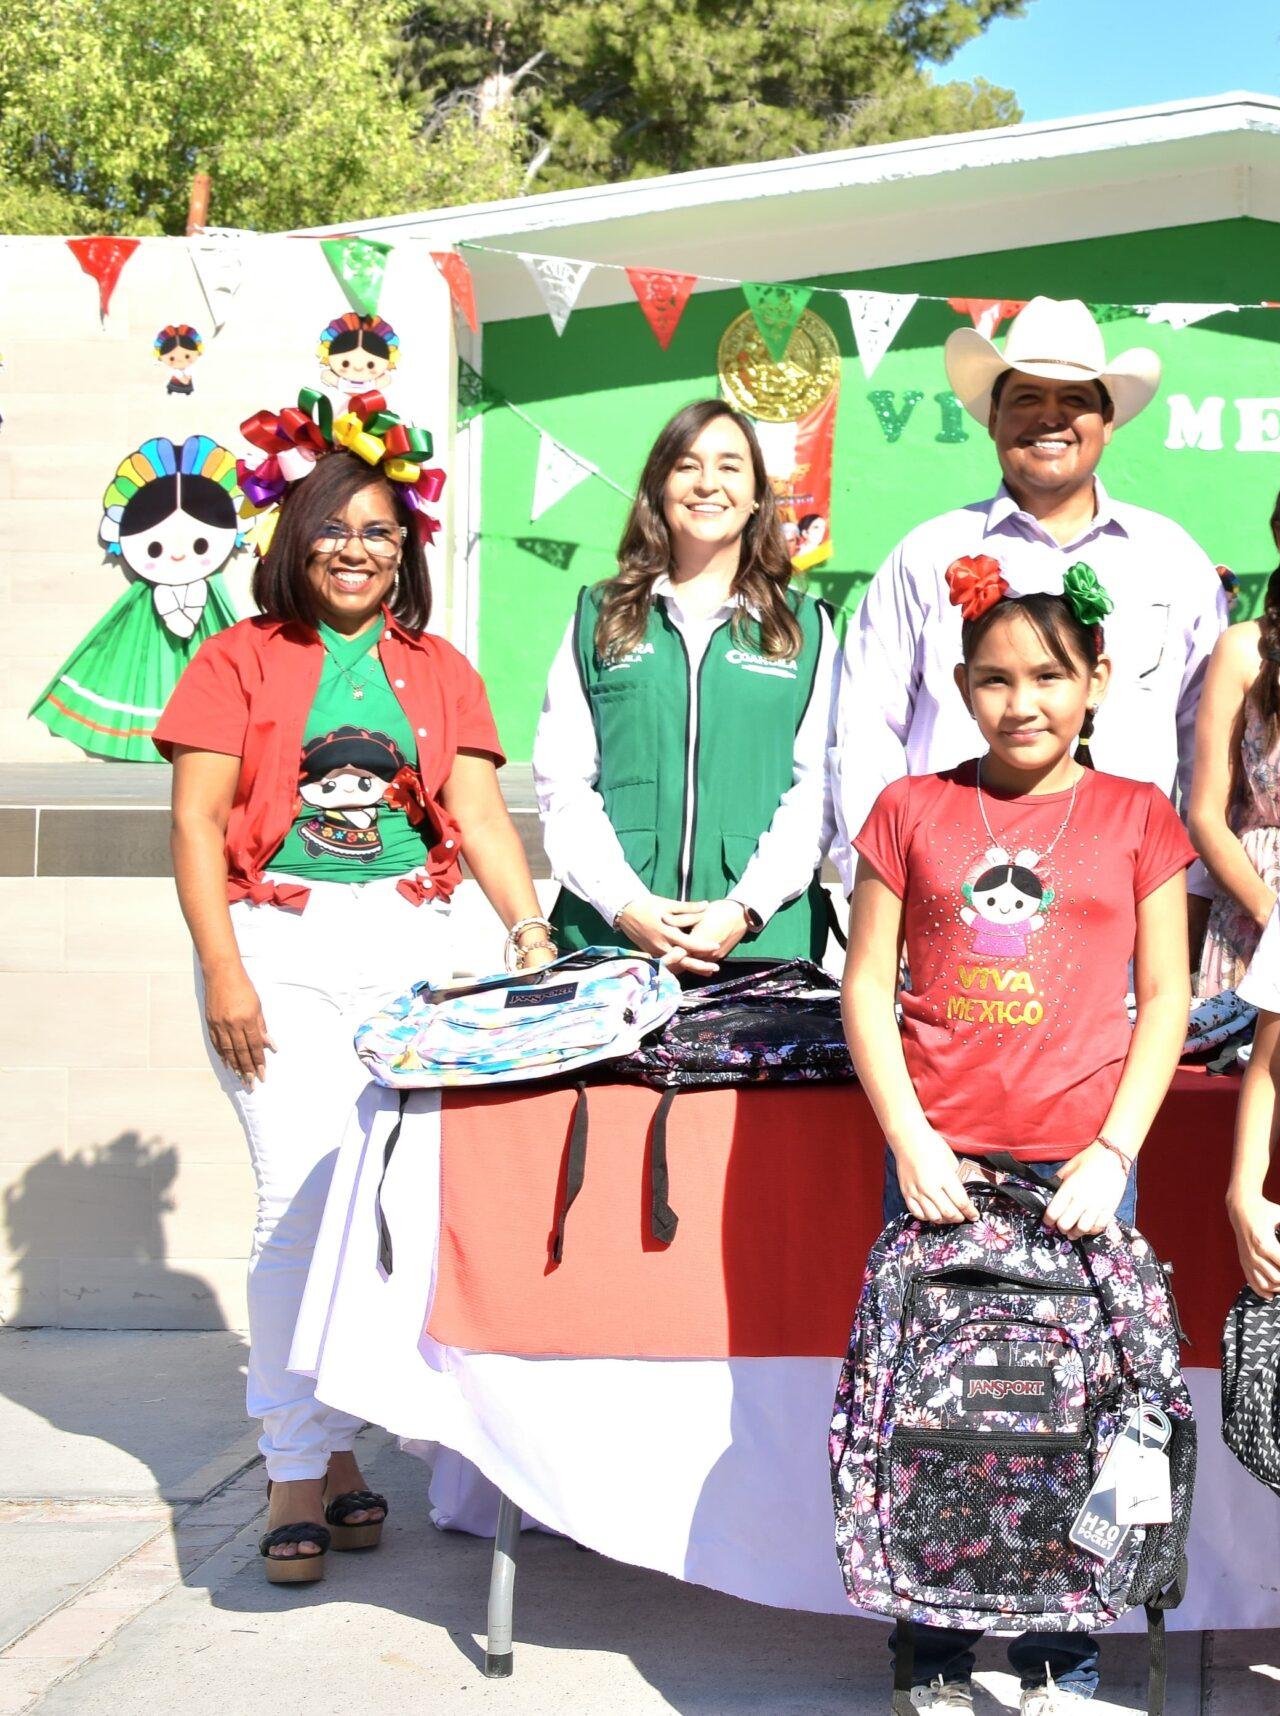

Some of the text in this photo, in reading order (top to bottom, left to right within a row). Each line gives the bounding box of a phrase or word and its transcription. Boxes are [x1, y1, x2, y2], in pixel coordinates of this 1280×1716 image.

[866, 389, 969, 443] VI
[957, 965, 1035, 994] VIVA
[946, 996, 1044, 1025] MEXICO
[967, 1379, 1045, 1399] JANSPORT
[1077, 1526, 1114, 1550] POCKET
